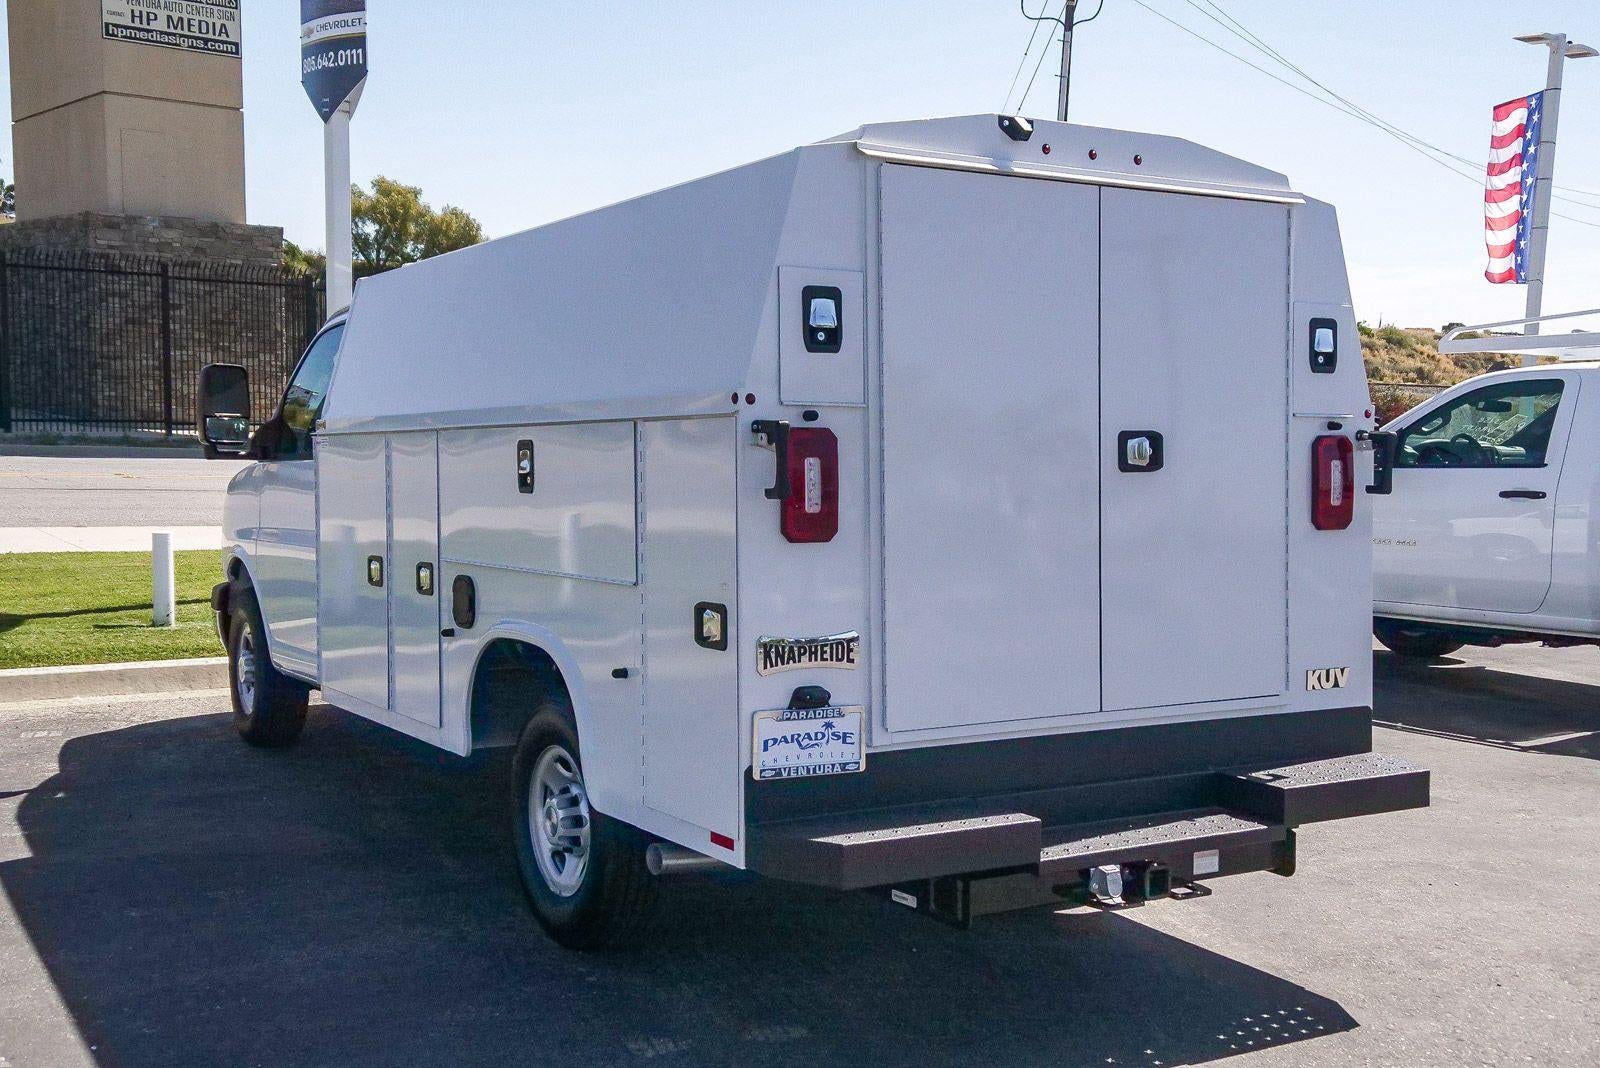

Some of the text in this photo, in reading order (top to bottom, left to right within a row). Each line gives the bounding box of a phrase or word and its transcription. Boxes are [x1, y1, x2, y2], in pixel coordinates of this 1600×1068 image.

[130, 9, 230, 38] HP MEDIA
[163, 1, 183, 14] AUTO
[186, 4, 215, 19] CENTER
[217, 9, 236, 22] SIGN
[315, 17, 363, 33] CHEVROLET
[108, 24, 236, 53] hpmediasigns.com
[302, 48, 363, 74] 805.642.0111
[762, 638, 856, 670] KNAPHEIDE
[1305, 666, 1350, 691] KUV
[783, 708, 841, 721] PARADISE
[762, 722, 856, 752] PARADISE
[761, 751, 856, 768] CHEVROLET
[780, 763, 843, 777] VENTURA
